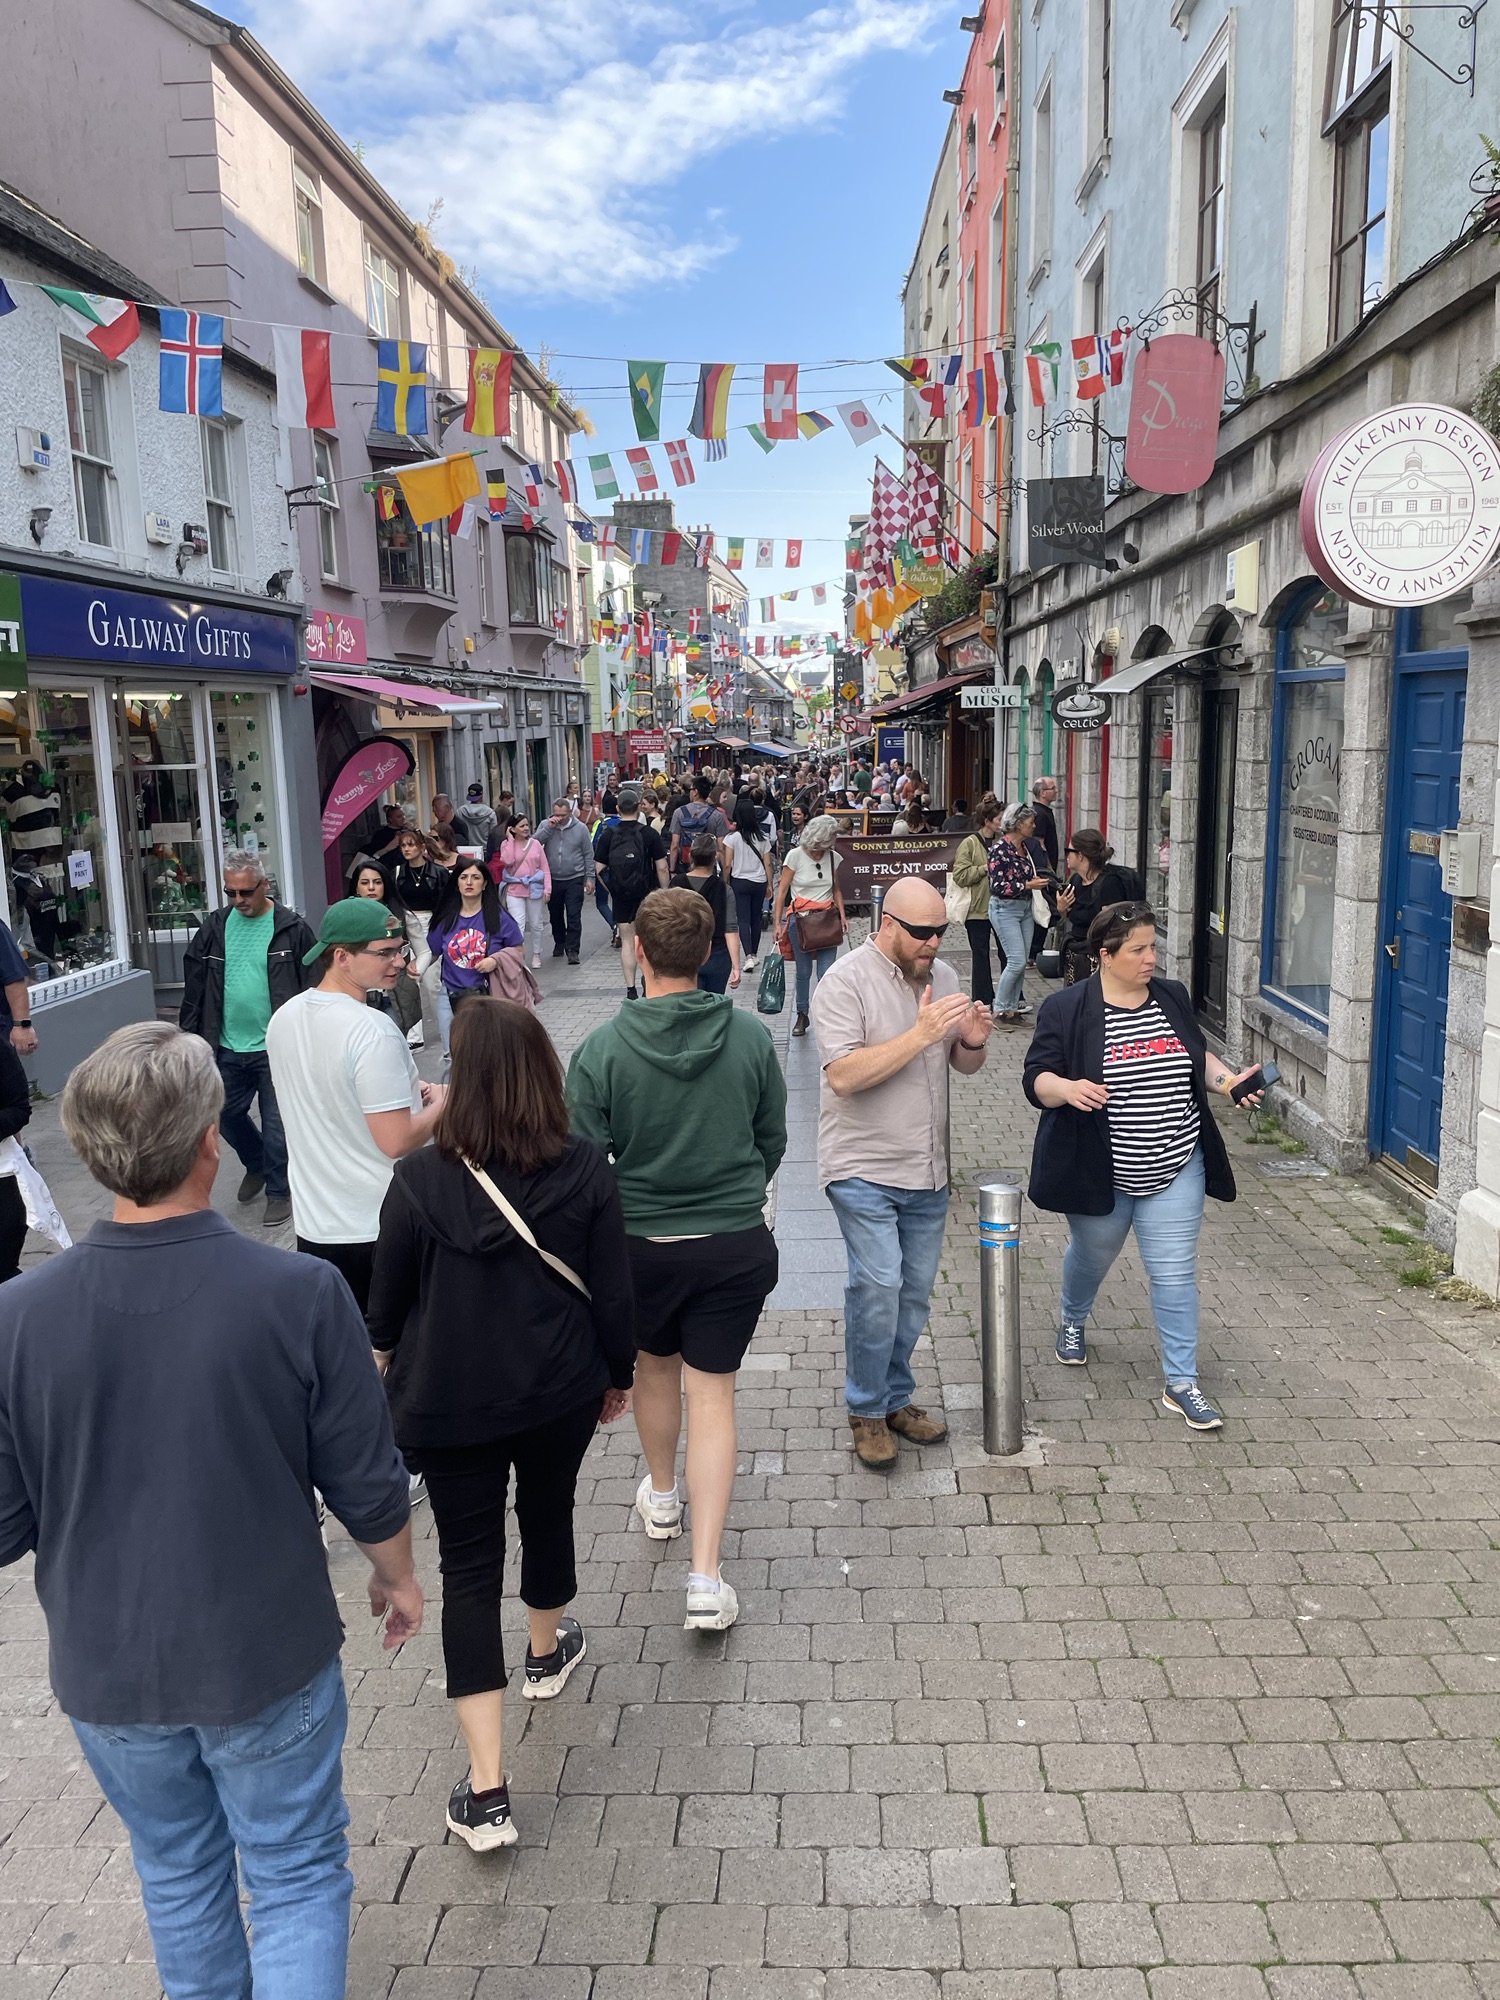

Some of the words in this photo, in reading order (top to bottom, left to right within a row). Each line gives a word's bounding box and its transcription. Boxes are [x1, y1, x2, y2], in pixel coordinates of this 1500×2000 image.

[1332, 415, 1427, 487] KILKENNY
[1434, 418, 1494, 482] DESIGN
[1325, 503, 1344, 511] EST.
[1481, 497, 1500, 506] 1963
[1031, 523, 1066, 538] Silver
[1066, 520, 1104, 535] Wood
[1330, 529, 1390, 591] DESIGN
[1399, 524, 1491, 594] KILKENNY
[87, 600, 186, 653] GALWAY
[195, 615, 251, 659] GIFTS
[306, 624, 326, 658] enny
[981, 686, 1001, 694] CEOL
[965, 694, 1017, 707] MUSIC
[1290, 804, 1313, 819] CHARTERED
[1293, 827, 1317, 843] REGISTERED
[852, 842, 890, 851] SONNY
[893, 840, 948, 849] MOLLOY'S
[75, 860, 85, 868] WET
[853, 866, 870, 874] THE
[872, 862, 921, 875] FRONT
[924, 863, 948, 871] DOOR
[74, 869, 88, 878] PAINT
